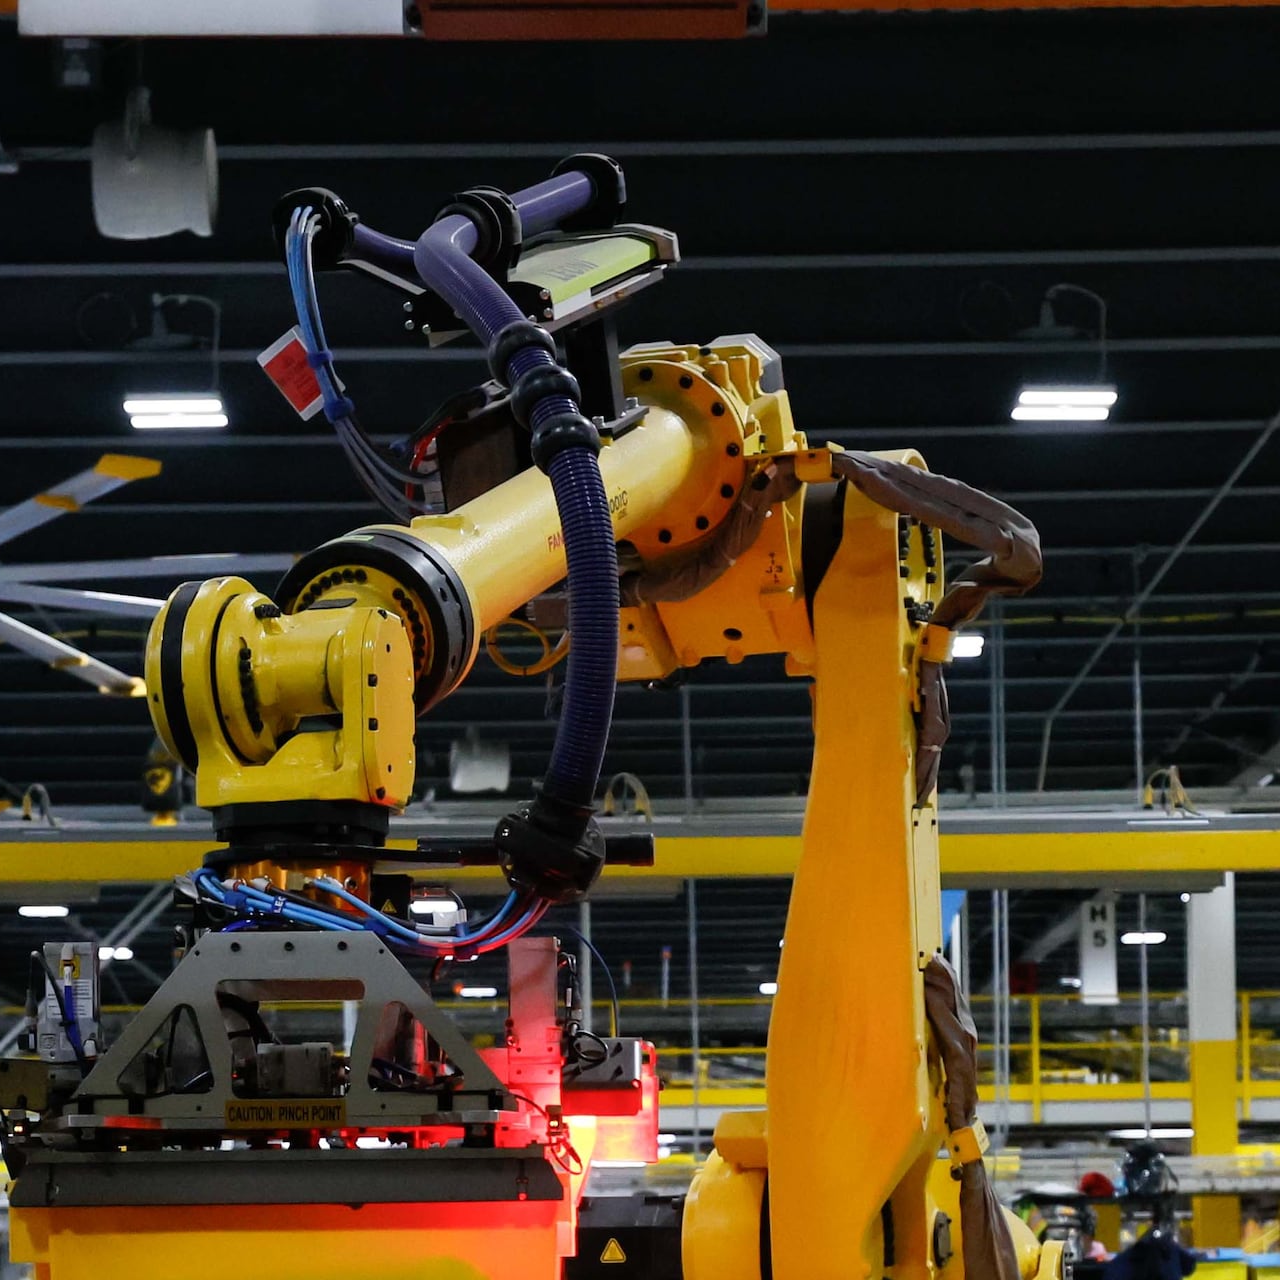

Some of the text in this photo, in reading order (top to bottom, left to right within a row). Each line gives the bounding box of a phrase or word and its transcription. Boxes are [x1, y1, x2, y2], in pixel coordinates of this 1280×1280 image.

[1090, 905, 1107, 922] H
[1093, 930, 1106, 948] 5
[280, 1105, 309, 1120] PINCH
[312, 1105, 341, 1120] POINT
